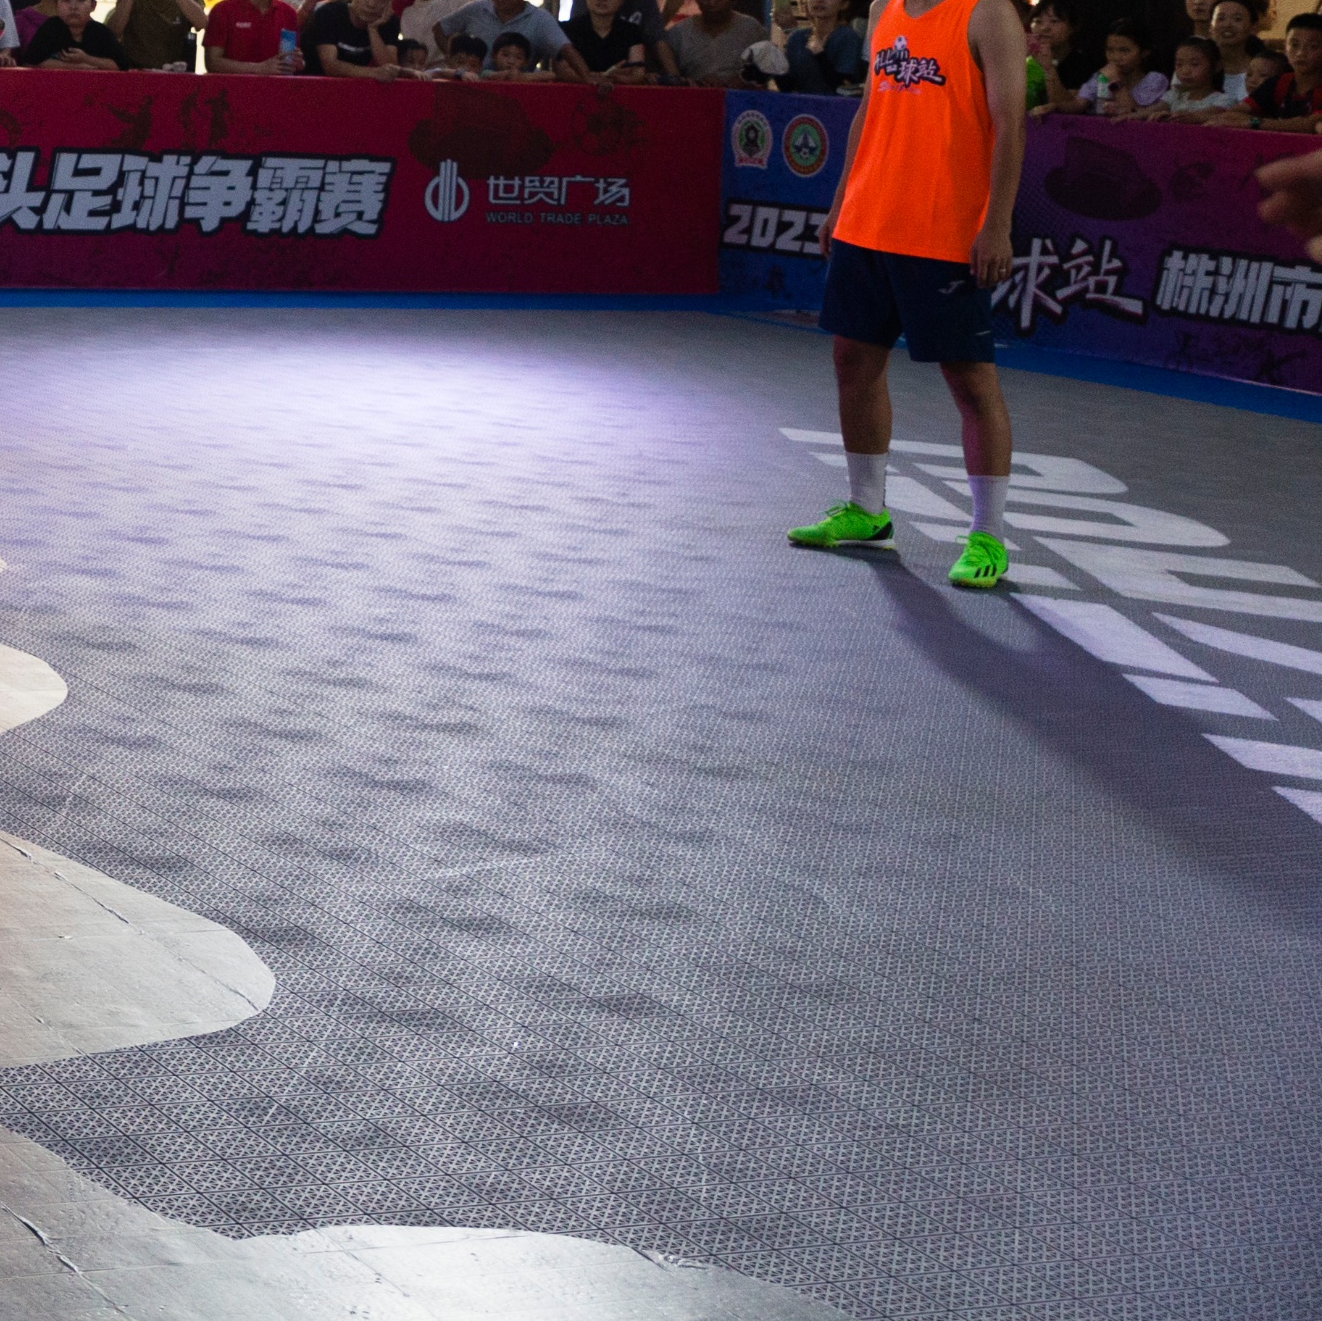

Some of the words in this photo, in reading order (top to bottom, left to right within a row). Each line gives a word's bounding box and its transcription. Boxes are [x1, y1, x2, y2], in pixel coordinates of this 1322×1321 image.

[486, 175, 631, 207] 世贸广场
[486, 212, 533, 224] WORLD
[540, 212, 581, 224] TRADE
[588, 213, 628, 226] PLAZA
